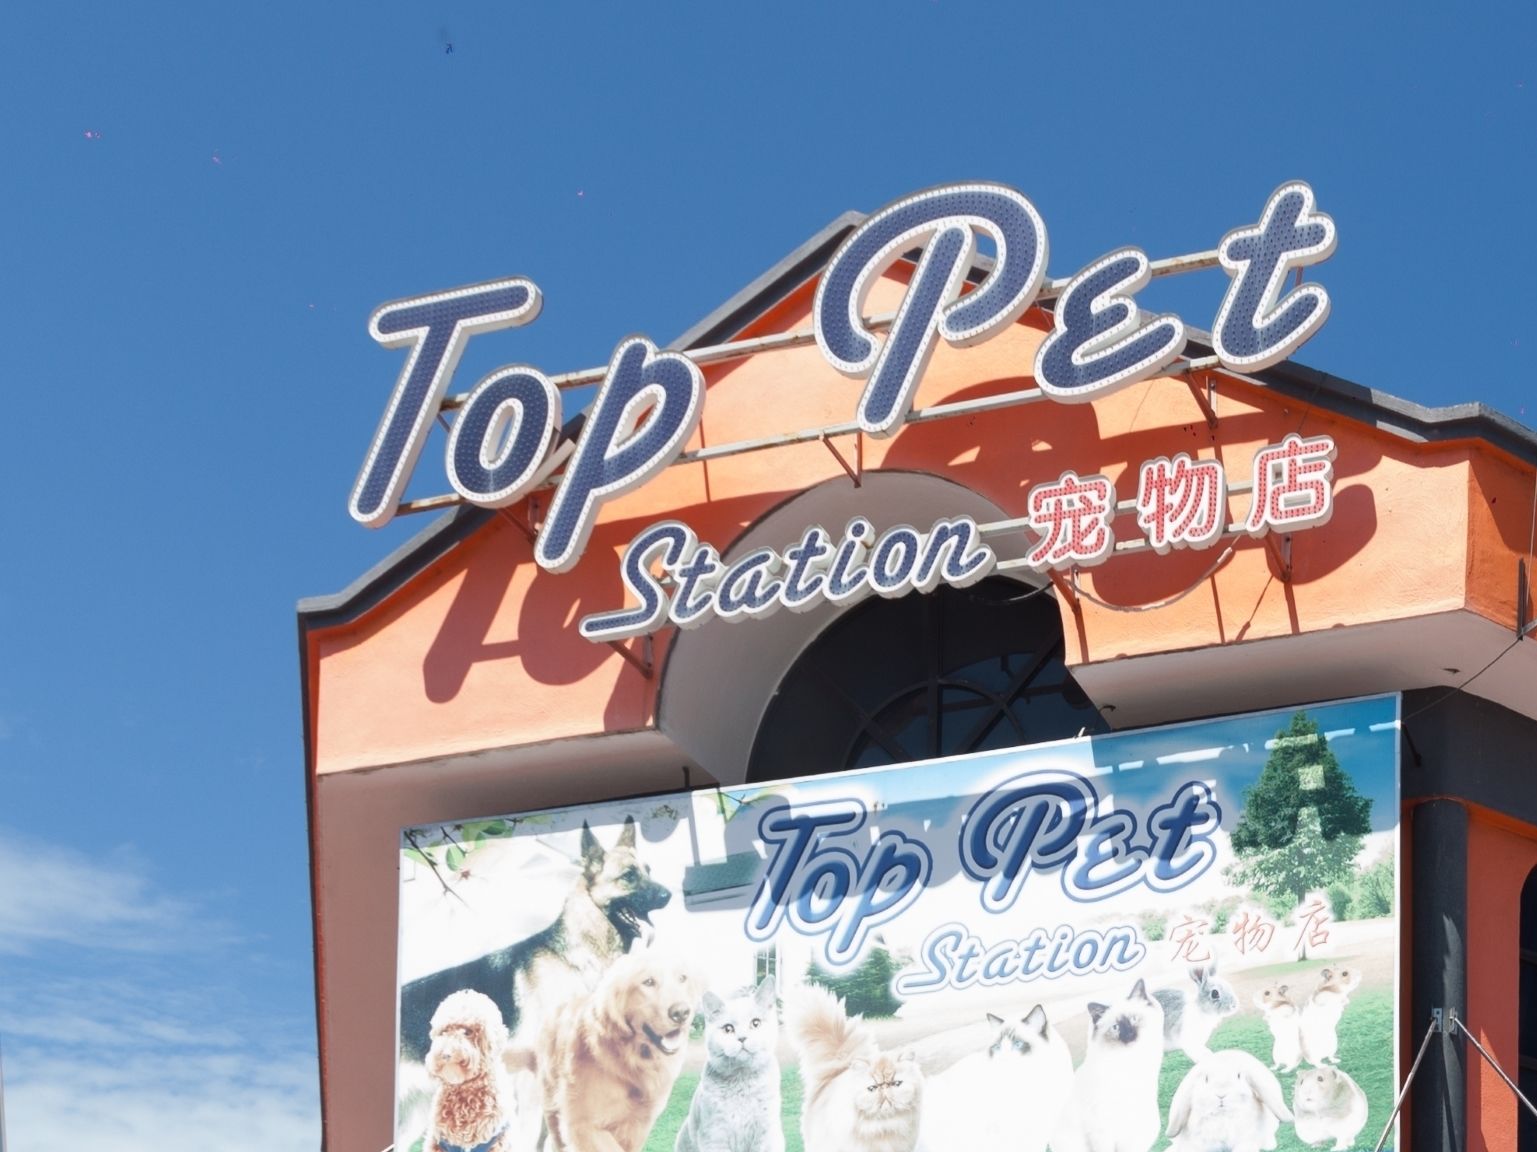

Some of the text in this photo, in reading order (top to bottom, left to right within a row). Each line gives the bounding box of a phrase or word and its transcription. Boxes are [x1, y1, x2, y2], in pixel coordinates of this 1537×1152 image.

[349, 180, 1338, 572] Top Pet
[1026, 435, 1336, 571] 宠物店
[578, 516, 999, 642] Station
[742, 768, 1224, 969] Top Pet
[1169, 901, 1331, 962] 宠物店
[895, 924, 1147, 995] Station
